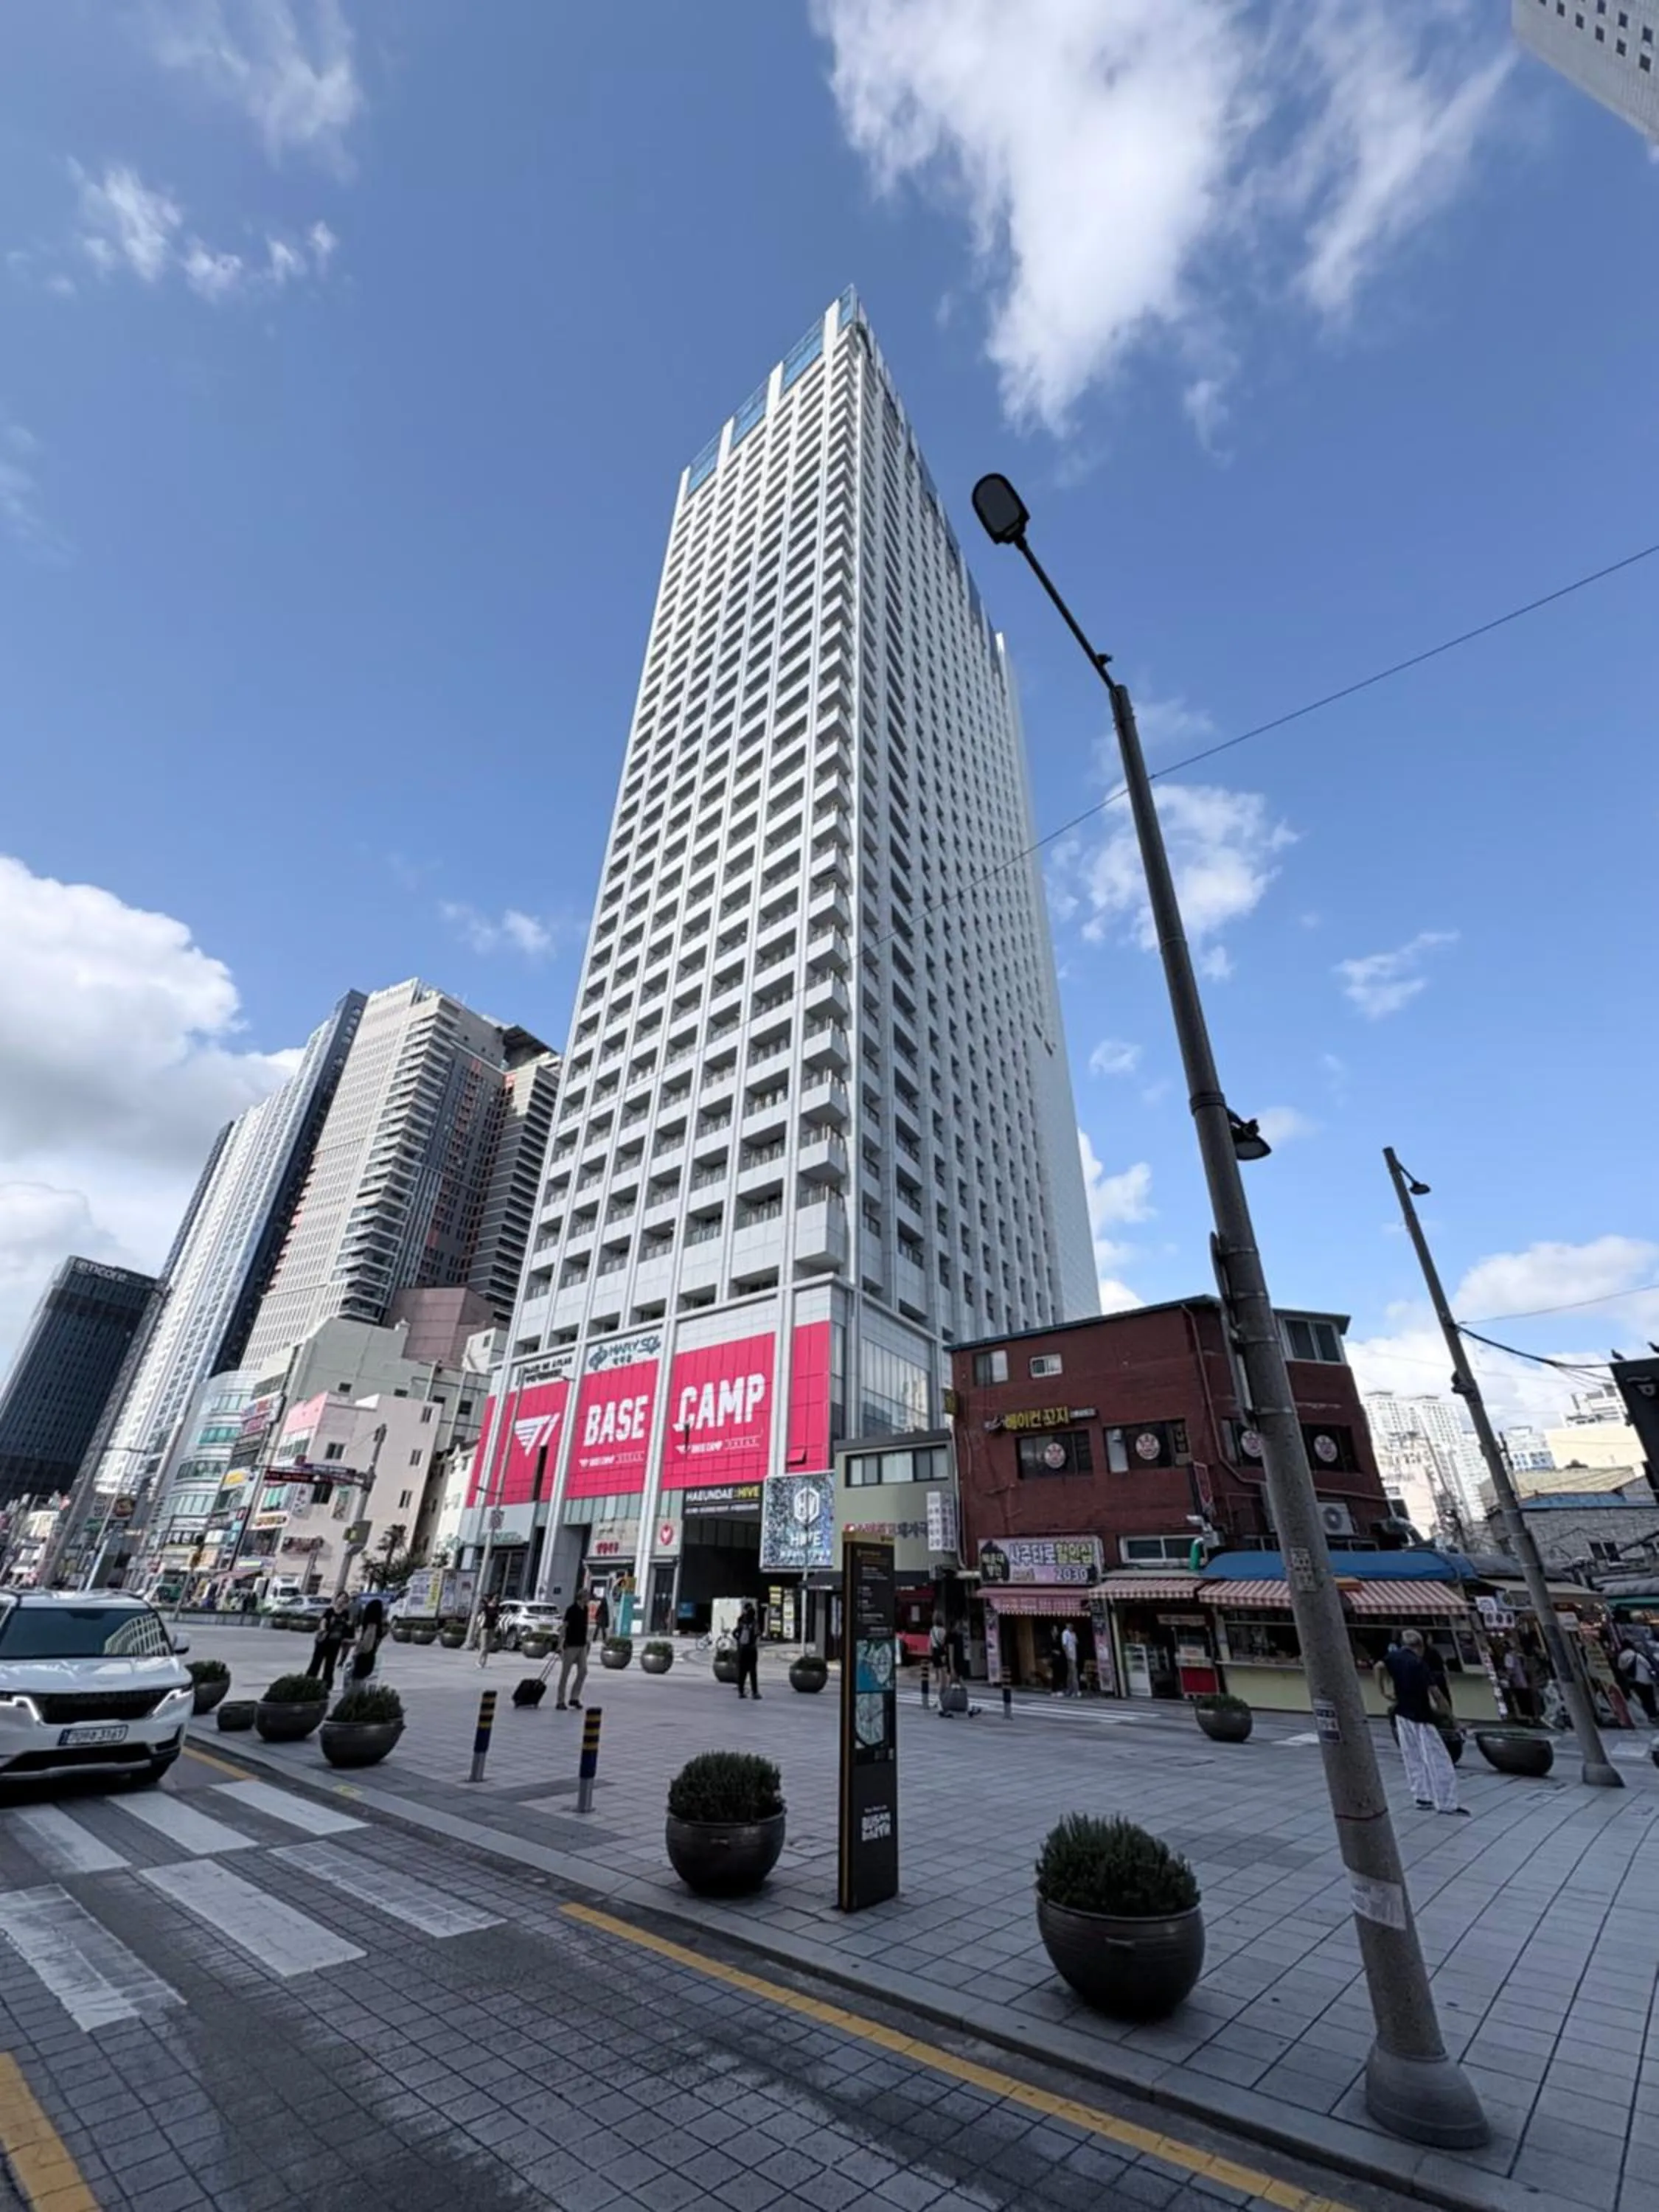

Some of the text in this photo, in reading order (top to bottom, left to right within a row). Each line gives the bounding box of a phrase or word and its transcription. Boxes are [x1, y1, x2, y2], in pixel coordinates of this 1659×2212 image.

[583, 1373, 765, 1447] BASE CAMP
[686, 1487, 734, 1503] HAEUNDAE
[1055, 1567, 1088, 1582] 2030
